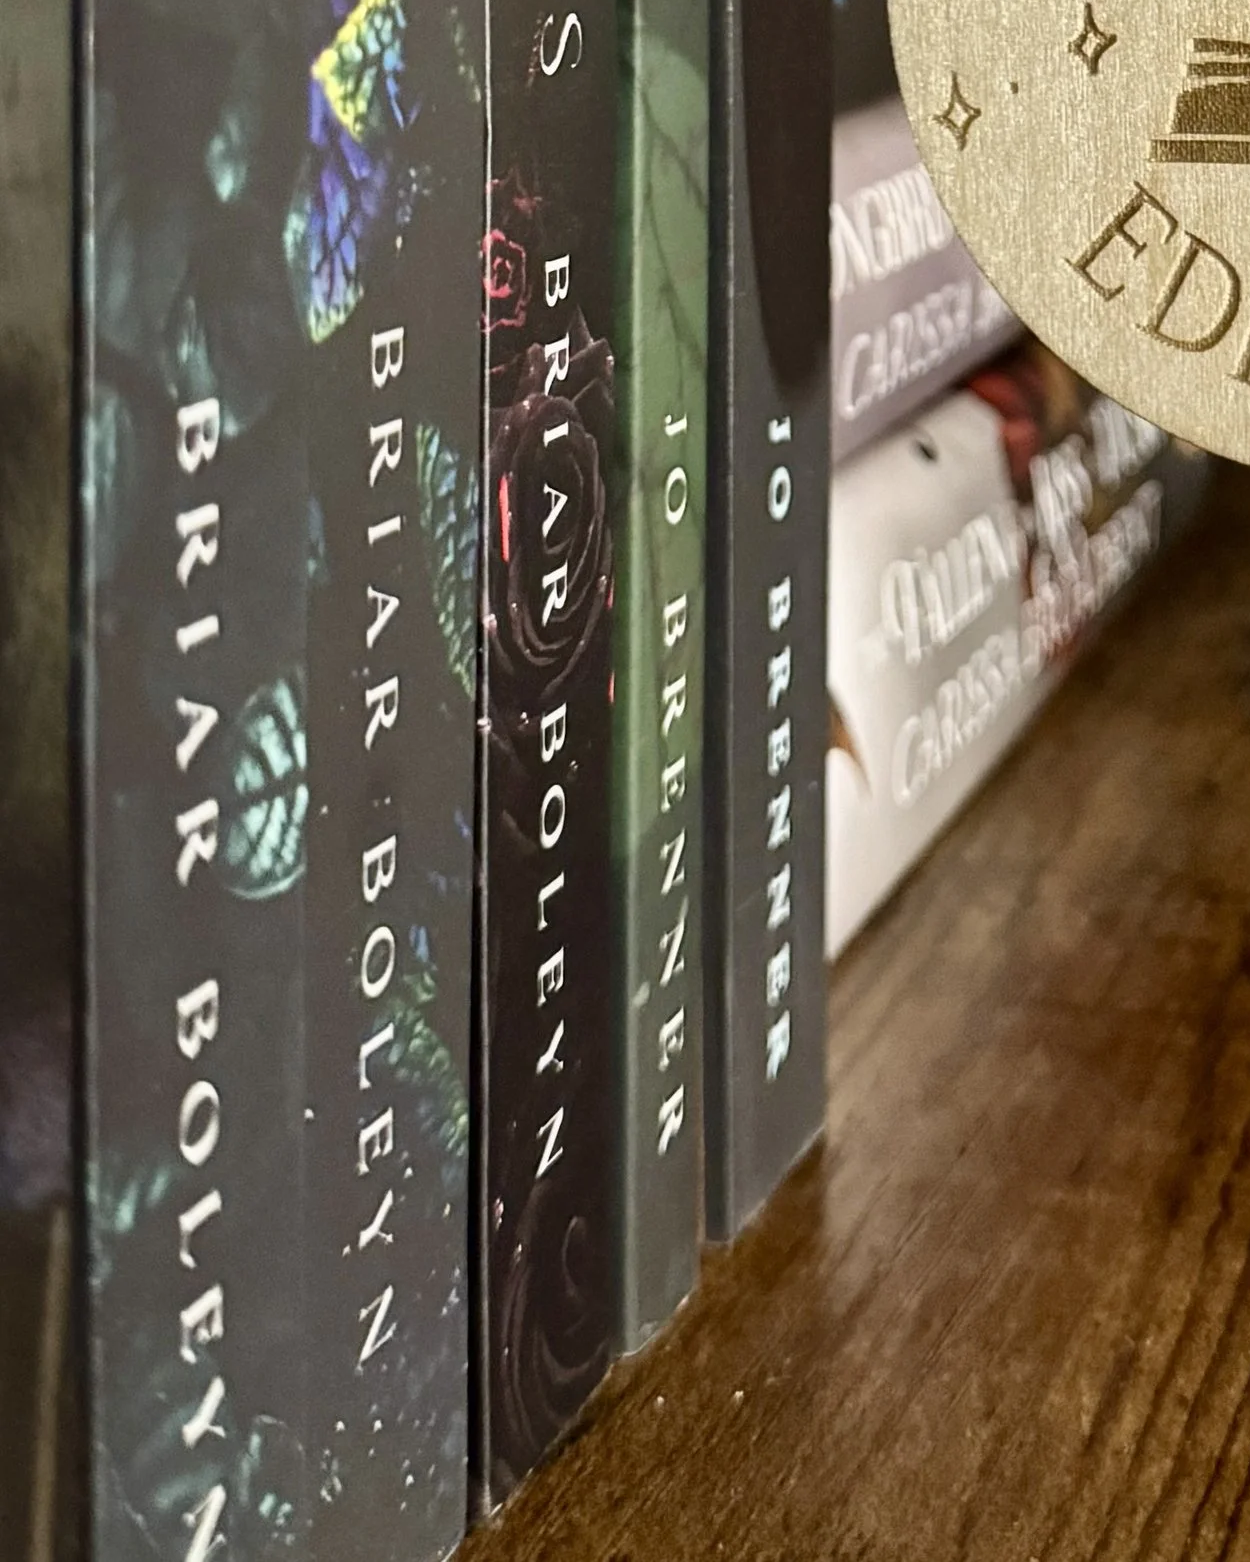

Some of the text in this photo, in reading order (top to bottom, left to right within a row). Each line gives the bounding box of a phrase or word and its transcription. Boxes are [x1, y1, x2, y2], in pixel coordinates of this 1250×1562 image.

[175, 396, 226, 1562] BRIAR BOLEYN
[357, 327, 405, 1372] BRIAR BOLEYN
[535, 254, 572, 1180] BRIAR BOLEYN
[657, 413, 688, 1154] JO BRENNER
[766, 416, 793, 1080] JO BRENNER
